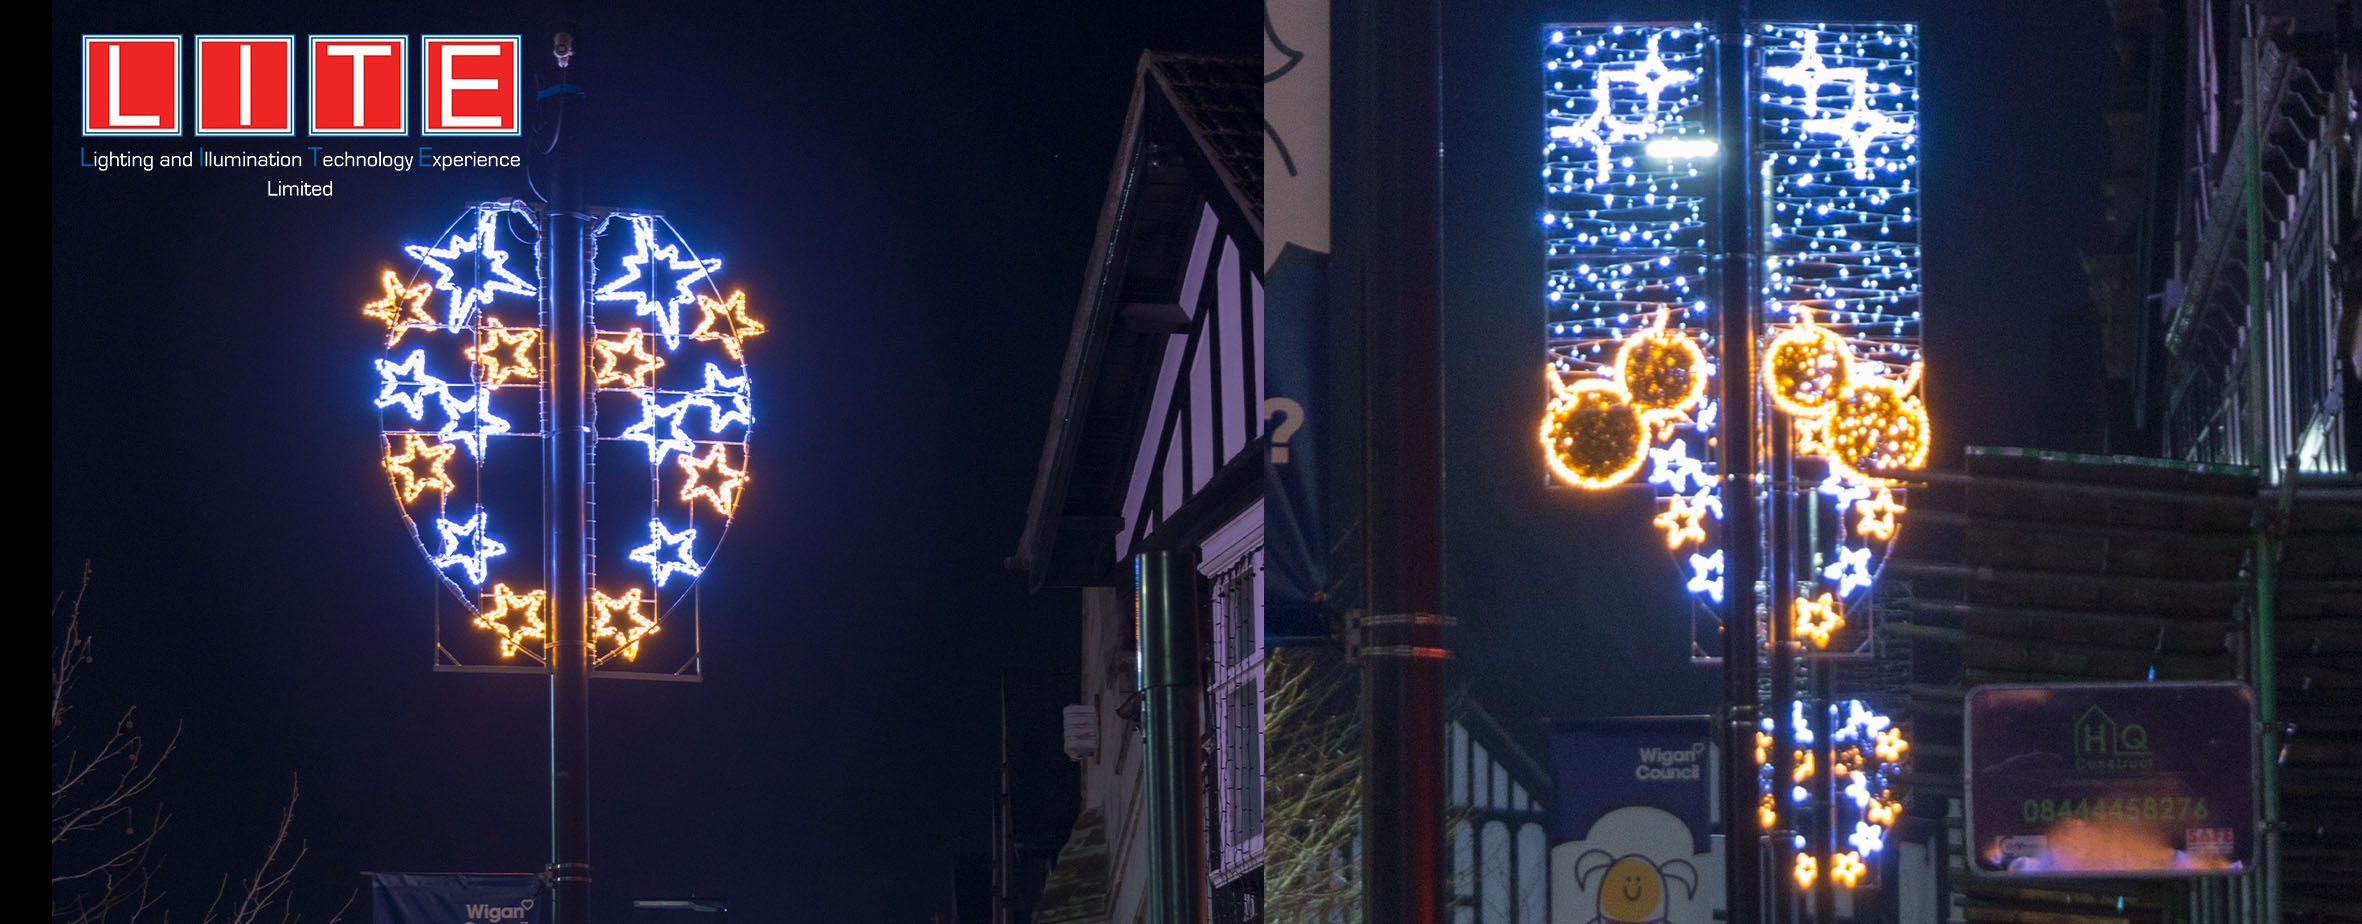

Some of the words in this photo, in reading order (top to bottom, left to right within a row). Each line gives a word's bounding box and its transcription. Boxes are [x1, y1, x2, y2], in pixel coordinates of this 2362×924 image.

[2084, 723, 2149, 752] HQ
[1639, 747, 1696, 766] Wigan
[1636, 764, 1700, 780] Council
[465, 903, 525, 924] Wigan
